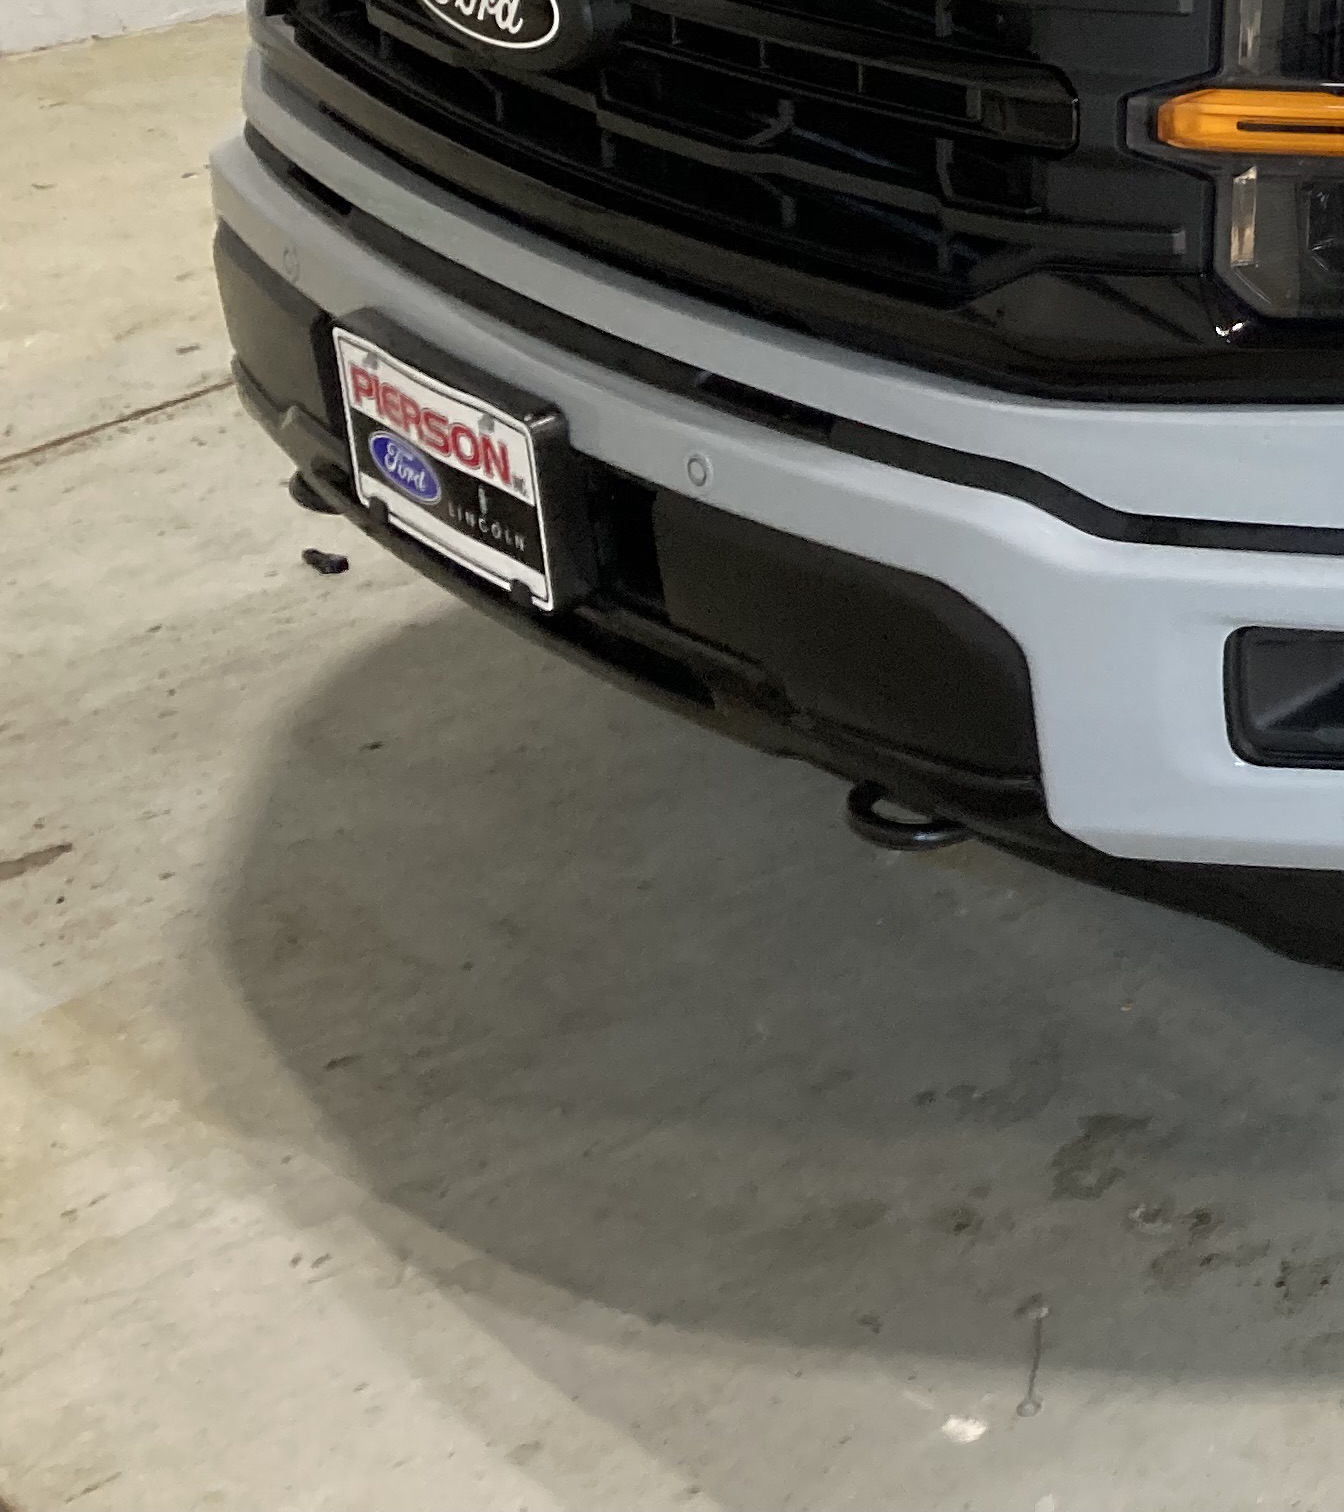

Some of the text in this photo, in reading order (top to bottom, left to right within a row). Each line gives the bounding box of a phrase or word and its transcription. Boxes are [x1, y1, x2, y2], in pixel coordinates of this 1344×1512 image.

[350, 363, 512, 486] PIERSON
[384, 441, 427, 492] Ford
[448, 501, 526, 552] LINCOLN
